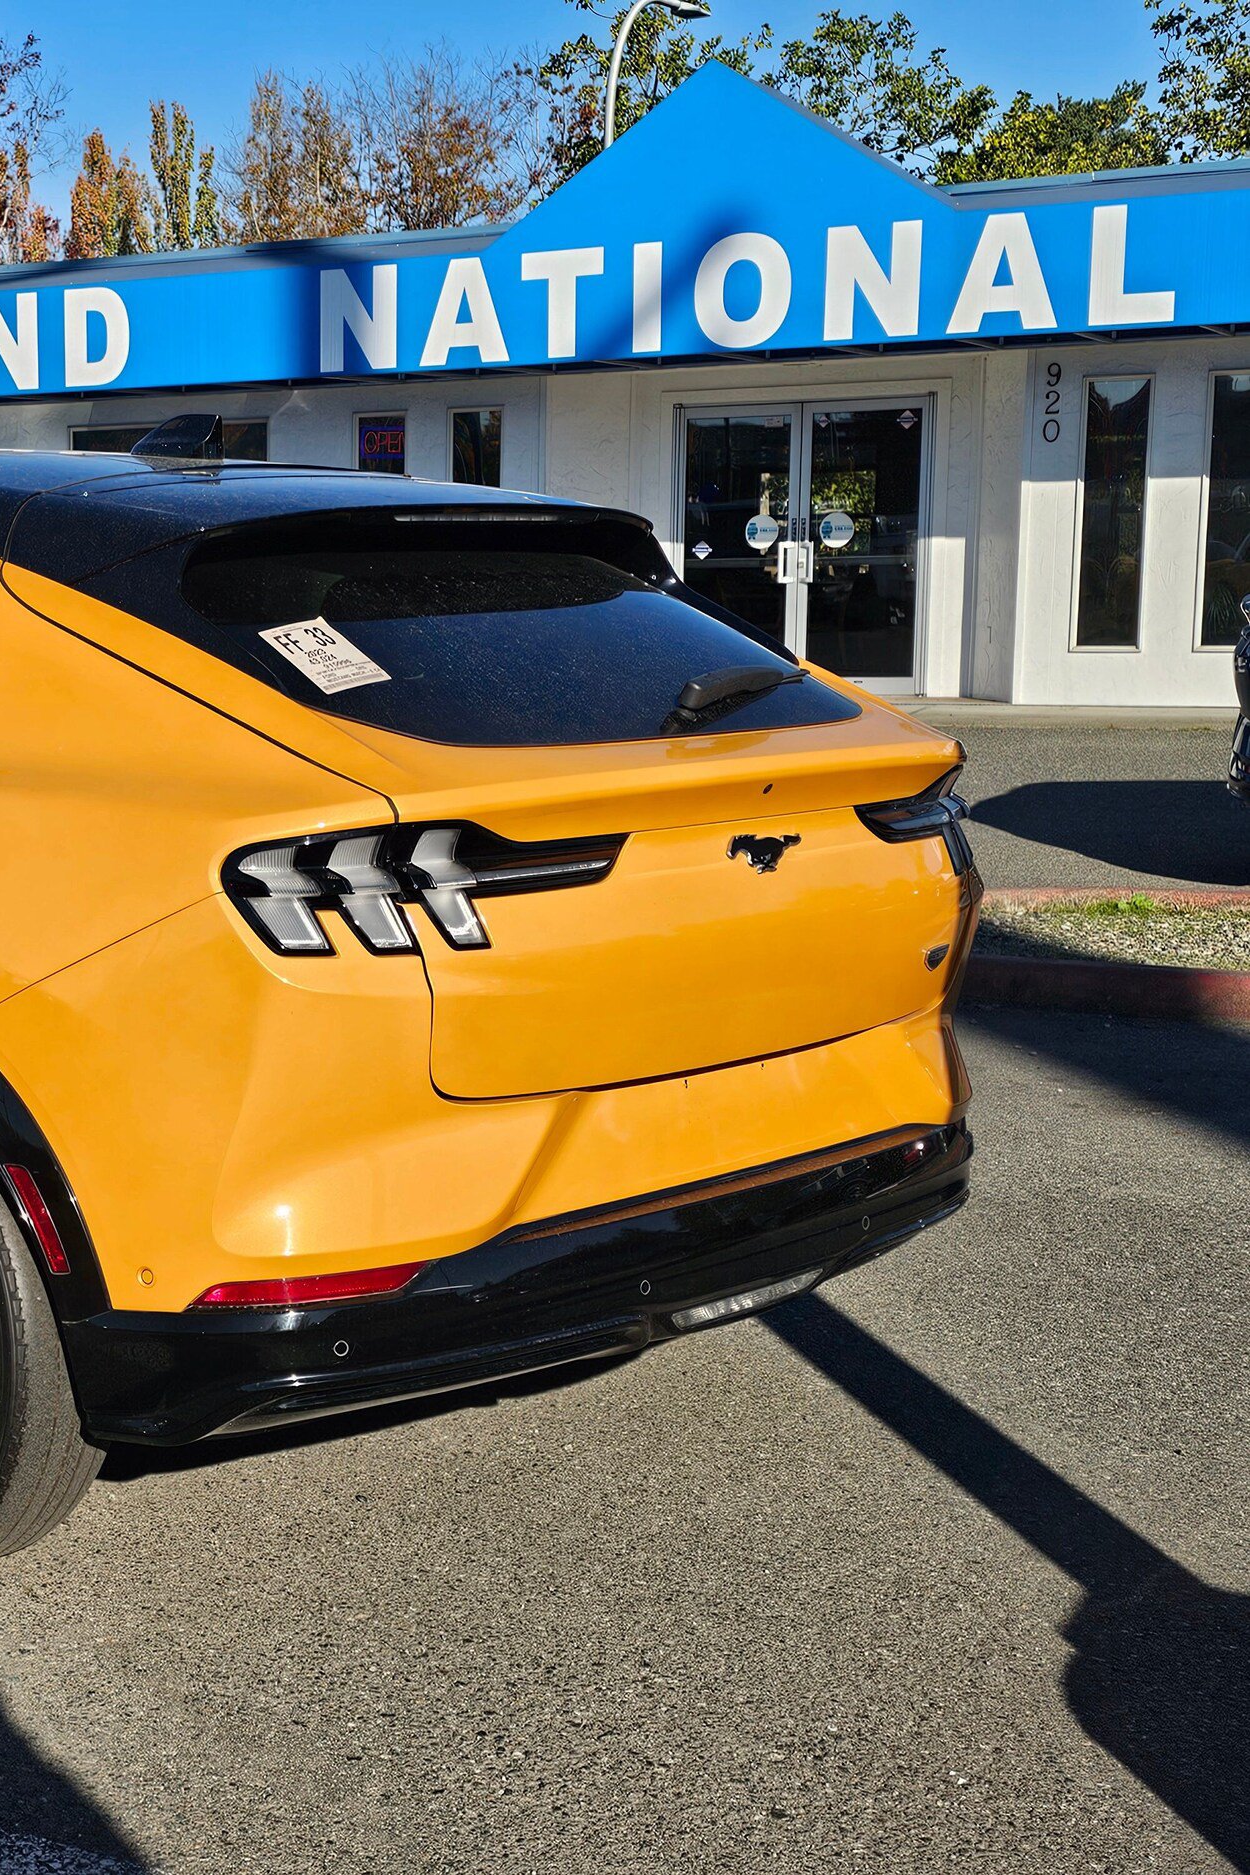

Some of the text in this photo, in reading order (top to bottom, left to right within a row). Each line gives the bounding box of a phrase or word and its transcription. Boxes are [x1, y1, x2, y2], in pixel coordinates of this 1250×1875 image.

[320, 204, 1176, 374] NATIONAL
[1043, 362, 1062, 443] 920
[273, 633, 304, 654] FF
[304, 627, 336, 646] 33
